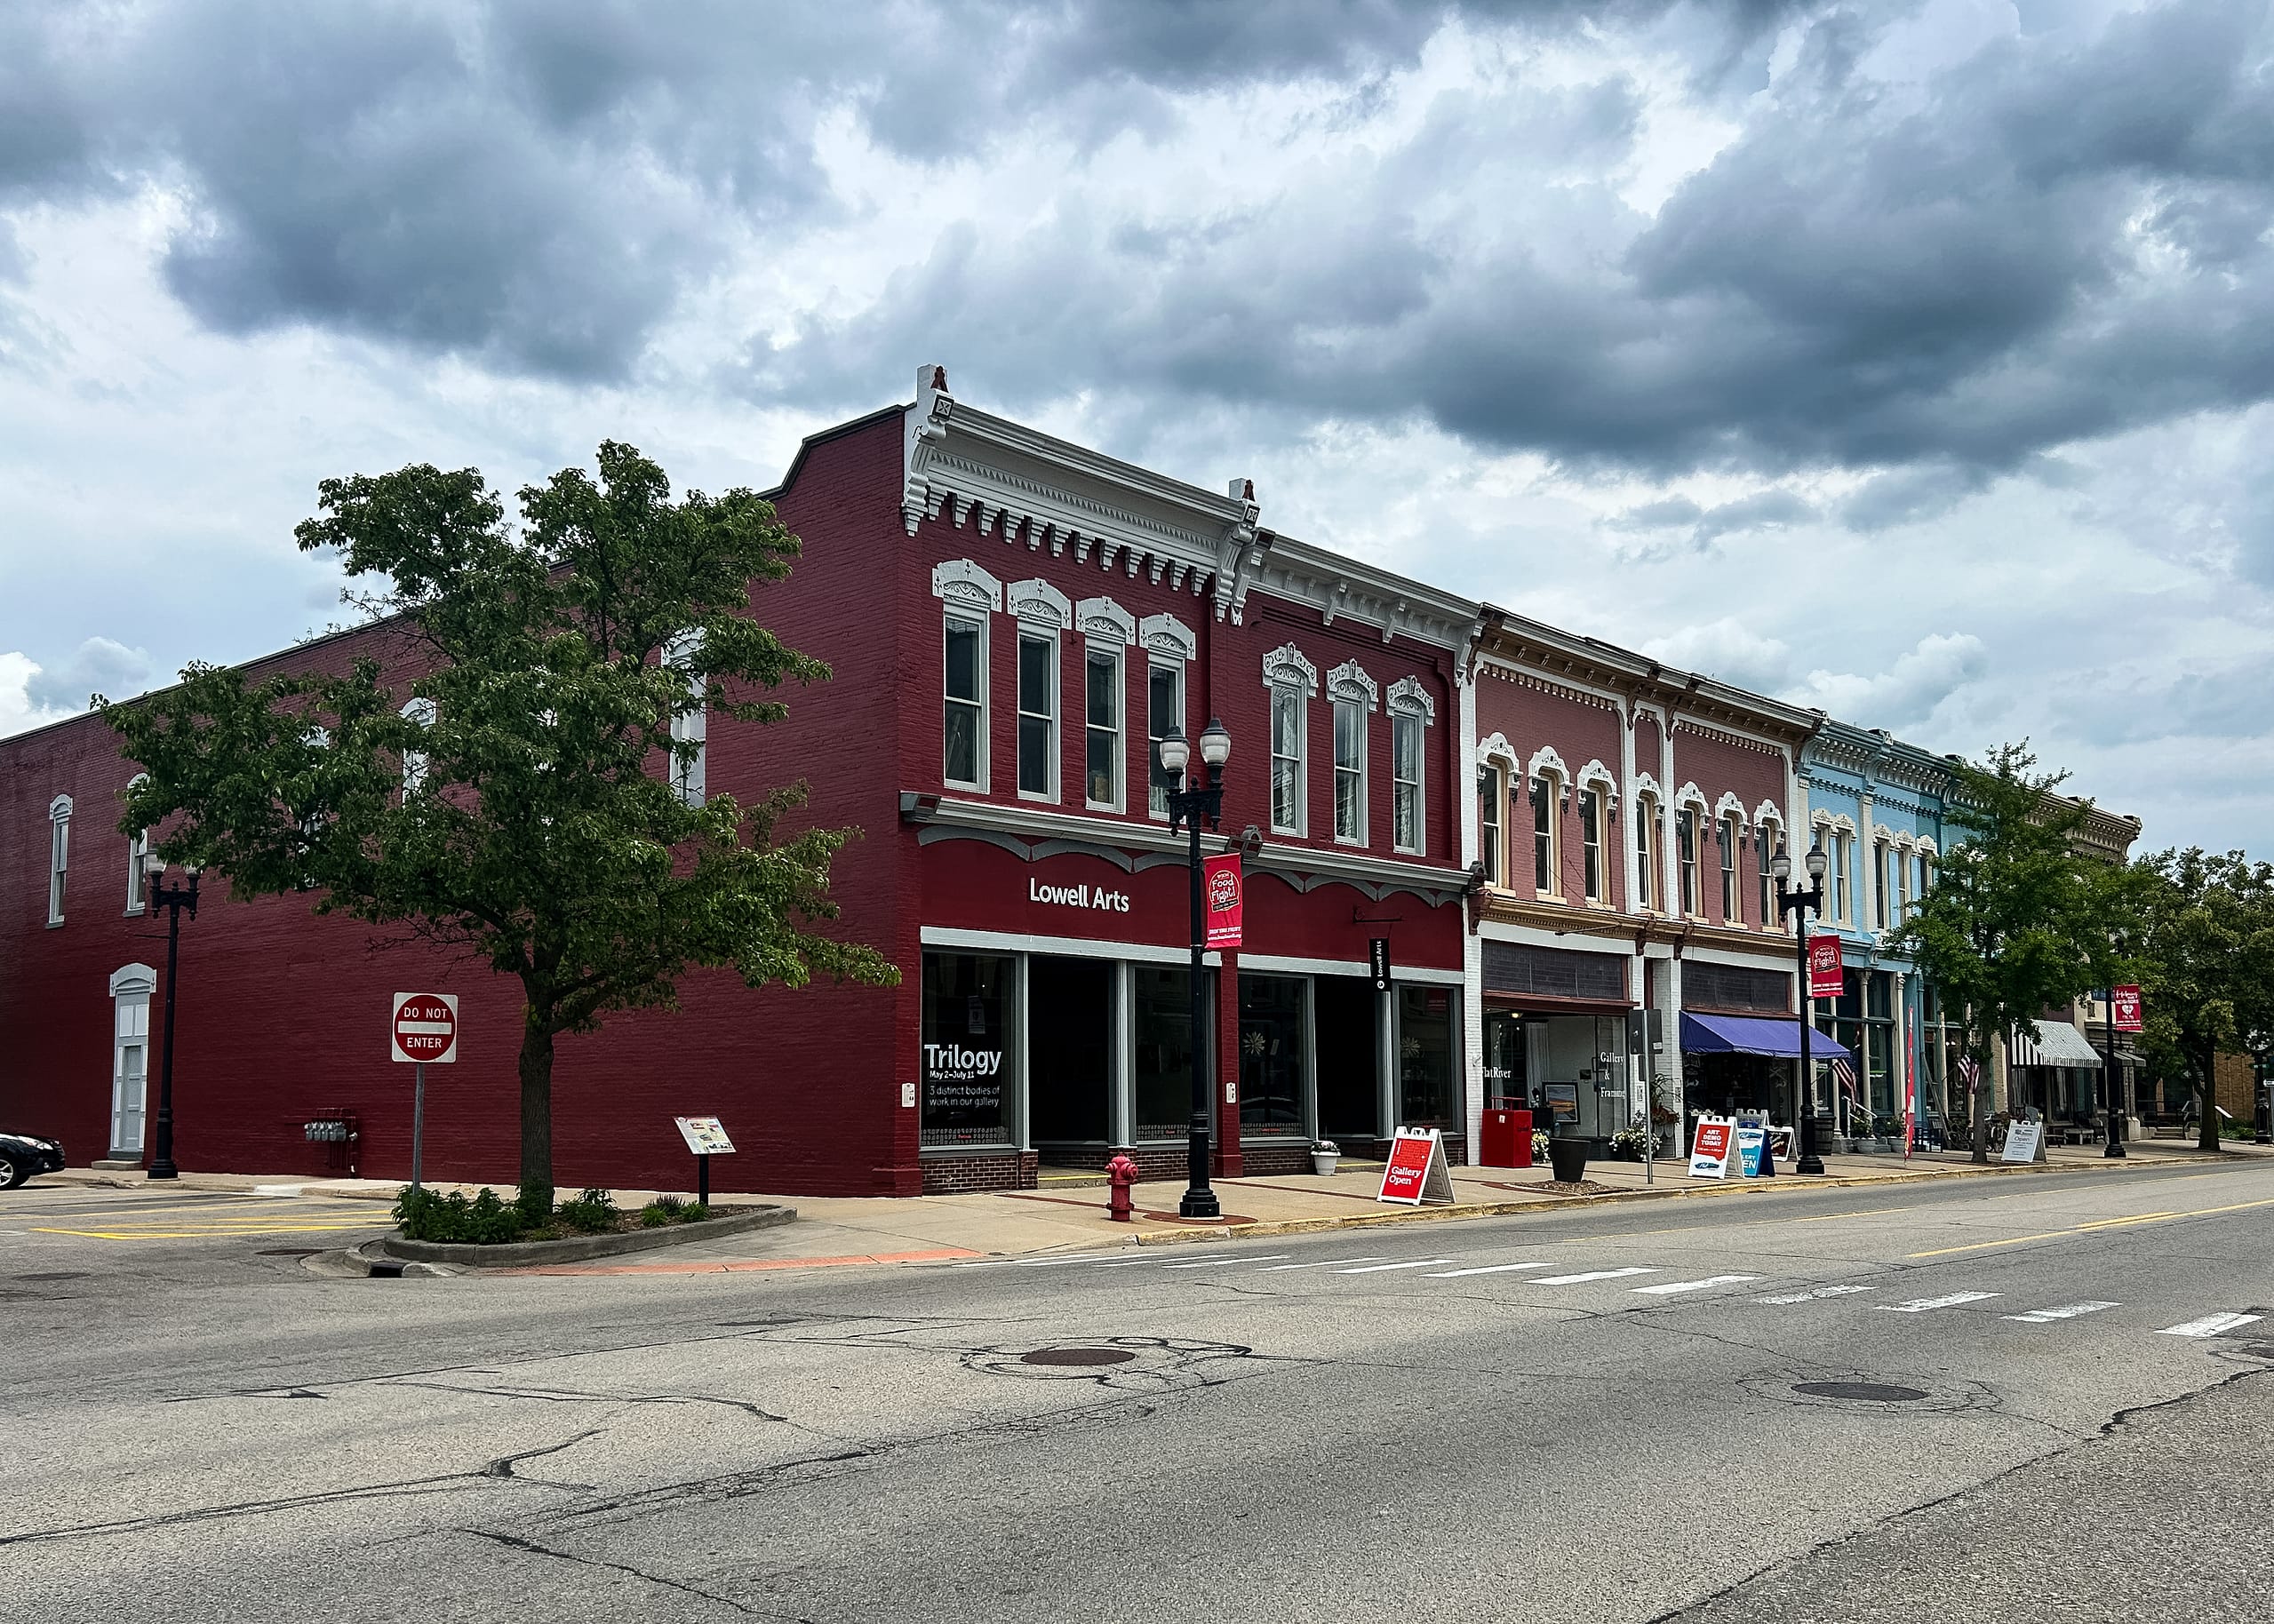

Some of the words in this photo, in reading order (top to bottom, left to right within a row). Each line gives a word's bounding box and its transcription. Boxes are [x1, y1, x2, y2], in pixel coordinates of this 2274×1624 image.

[1212, 875, 1234, 890] Food
[1031, 878, 1089, 907] Lowell
[1092, 888, 1129, 912] Arts
[1211, 887, 1235, 903] Fight!
[404, 1007, 419, 1018] DO
[427, 1007, 448, 1019] NOT
[407, 1037, 442, 1048] ENTER
[924, 1044, 1002, 1075] Trilogy
[1600, 1052, 1624, 1066] Gallery
[930, 1071, 943, 1079] May
[1604, 1069, 1610, 1080] &
[930, 1086, 935, 1095] 3
[937, 1086, 964, 1095] distinct
[965, 1086, 991, 1095] bodies
[993, 1086, 1000, 1095] of
[930, 1097, 949, 1106] work
[975, 1097, 999, 1108] gallery
[1743, 1160, 1756, 1169] EN
[1392, 1166, 1422, 1178] Gallery
[1389, 1175, 1411, 1185] Open
